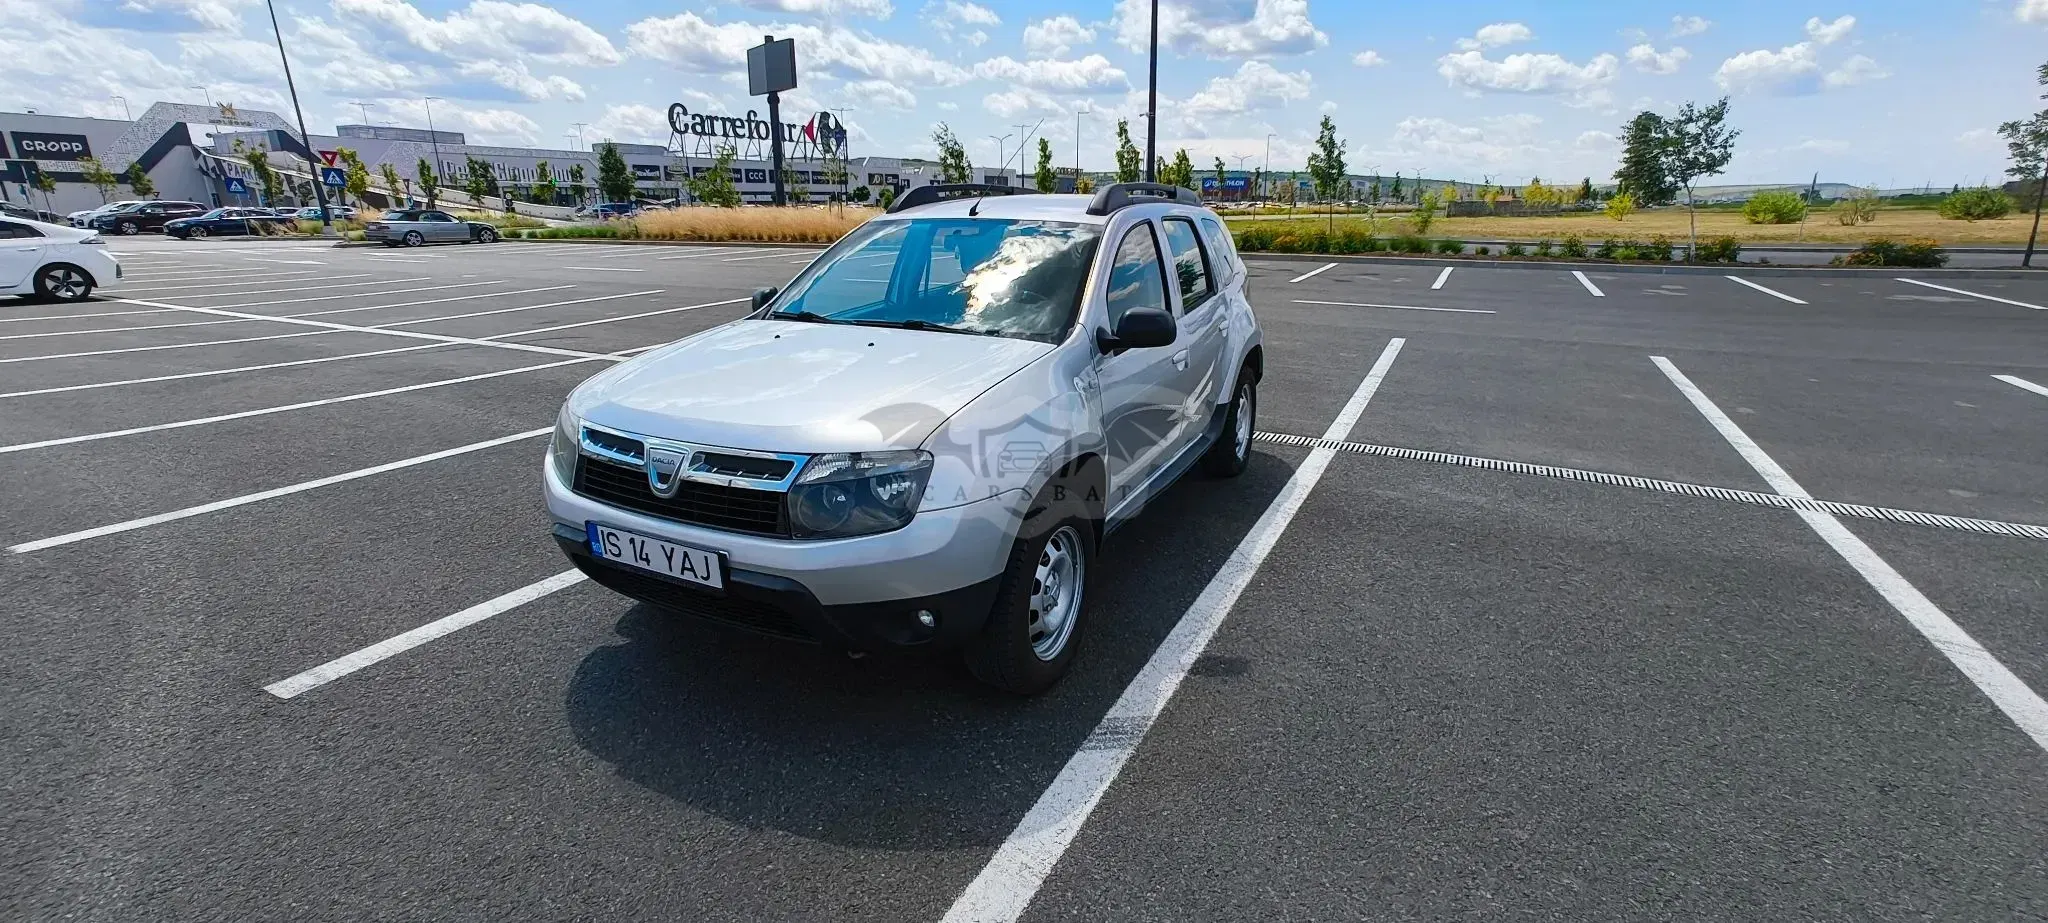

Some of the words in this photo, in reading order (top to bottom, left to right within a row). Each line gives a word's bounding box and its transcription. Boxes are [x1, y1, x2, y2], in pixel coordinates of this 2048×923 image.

[22, 140, 83, 152] CROPP
[748, 172, 764, 180] CCC
[652, 456, 676, 465] DACIA
[600, 530, 622, 557] IS
[629, 537, 650, 566] 14
[661, 544, 711, 581] YAJ
